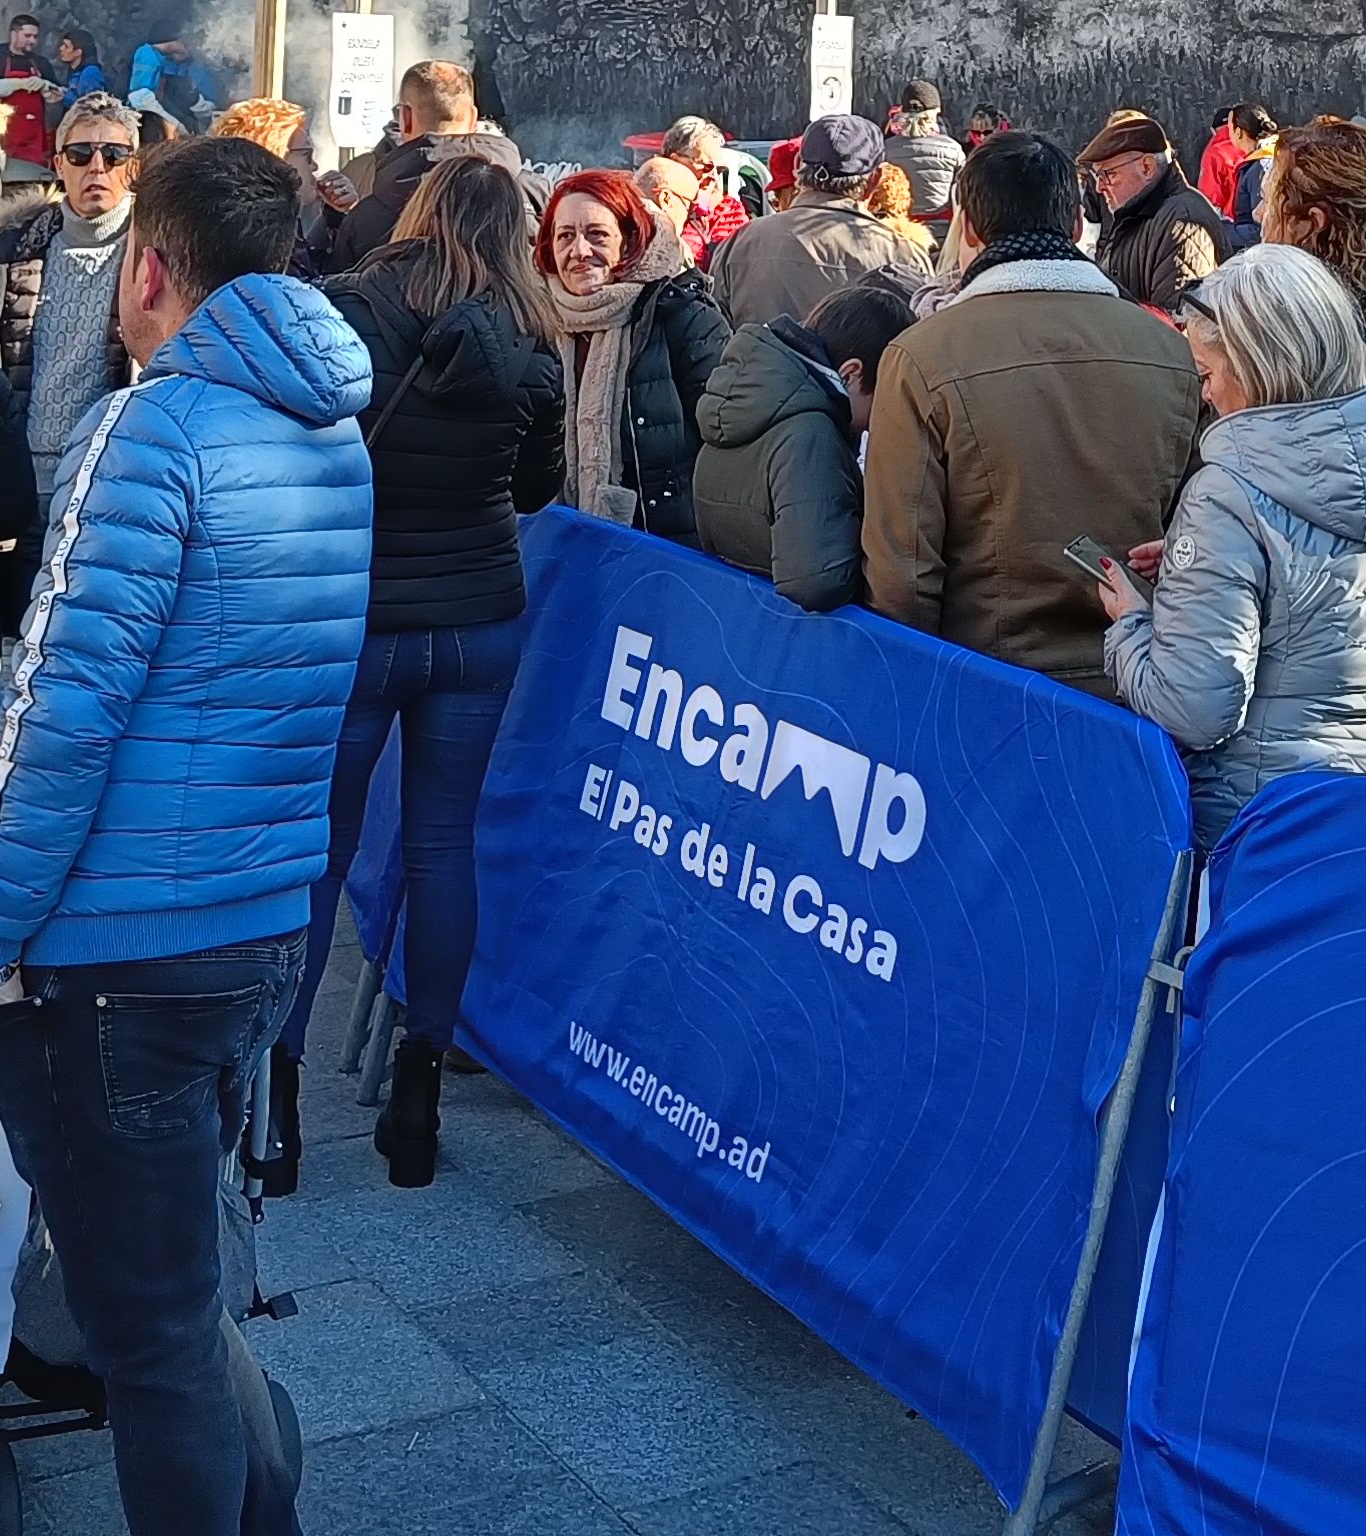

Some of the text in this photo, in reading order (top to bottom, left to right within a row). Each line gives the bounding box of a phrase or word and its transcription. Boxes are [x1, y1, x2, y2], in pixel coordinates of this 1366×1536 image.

[600, 624, 927, 871] Encamp
[579, 763, 899, 983] El Pas de la Casa
[568, 1020, 772, 1184] www.encamp.ad
